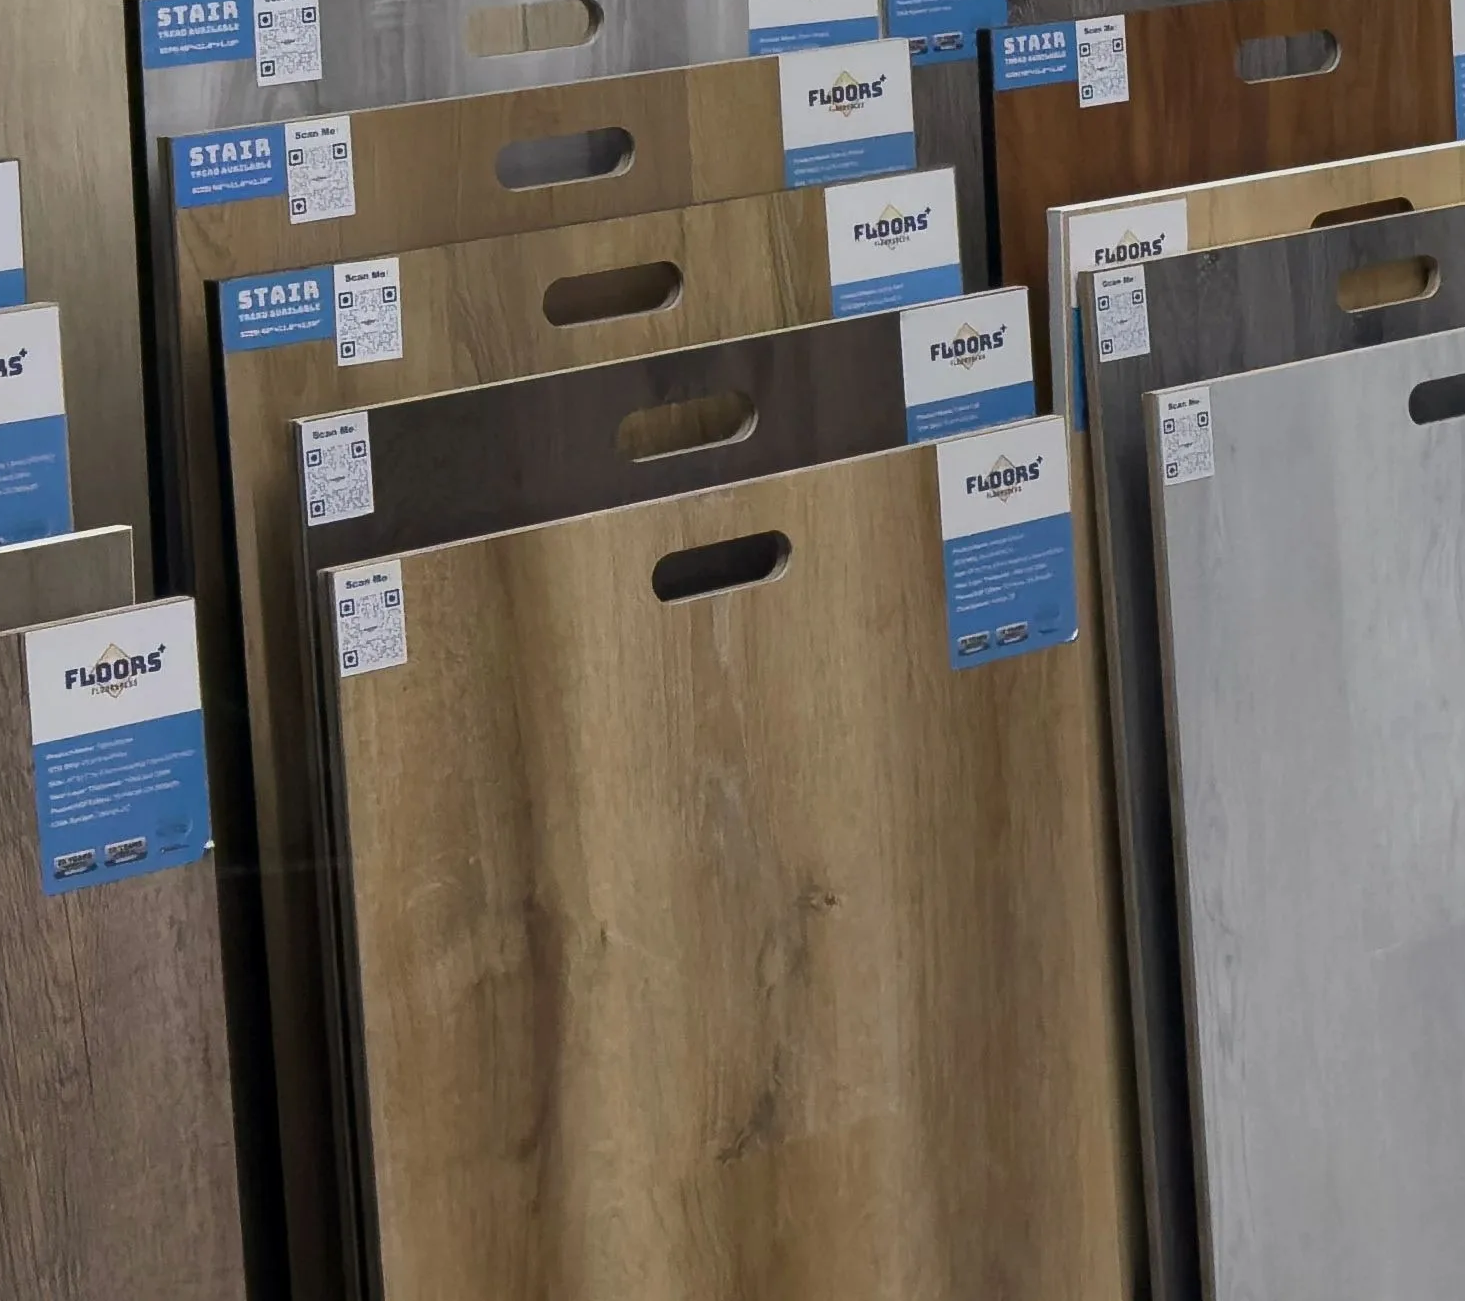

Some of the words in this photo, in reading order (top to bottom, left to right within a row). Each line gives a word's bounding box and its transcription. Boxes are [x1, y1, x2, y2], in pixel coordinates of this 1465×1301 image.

[157, 0, 238, 28] STAIR
[1004, 31, 1065, 55] STAIR
[190, 137, 271, 167] STAIR
[238, 280, 320, 310] STAIR
[345, 578, 371, 590] Scan
